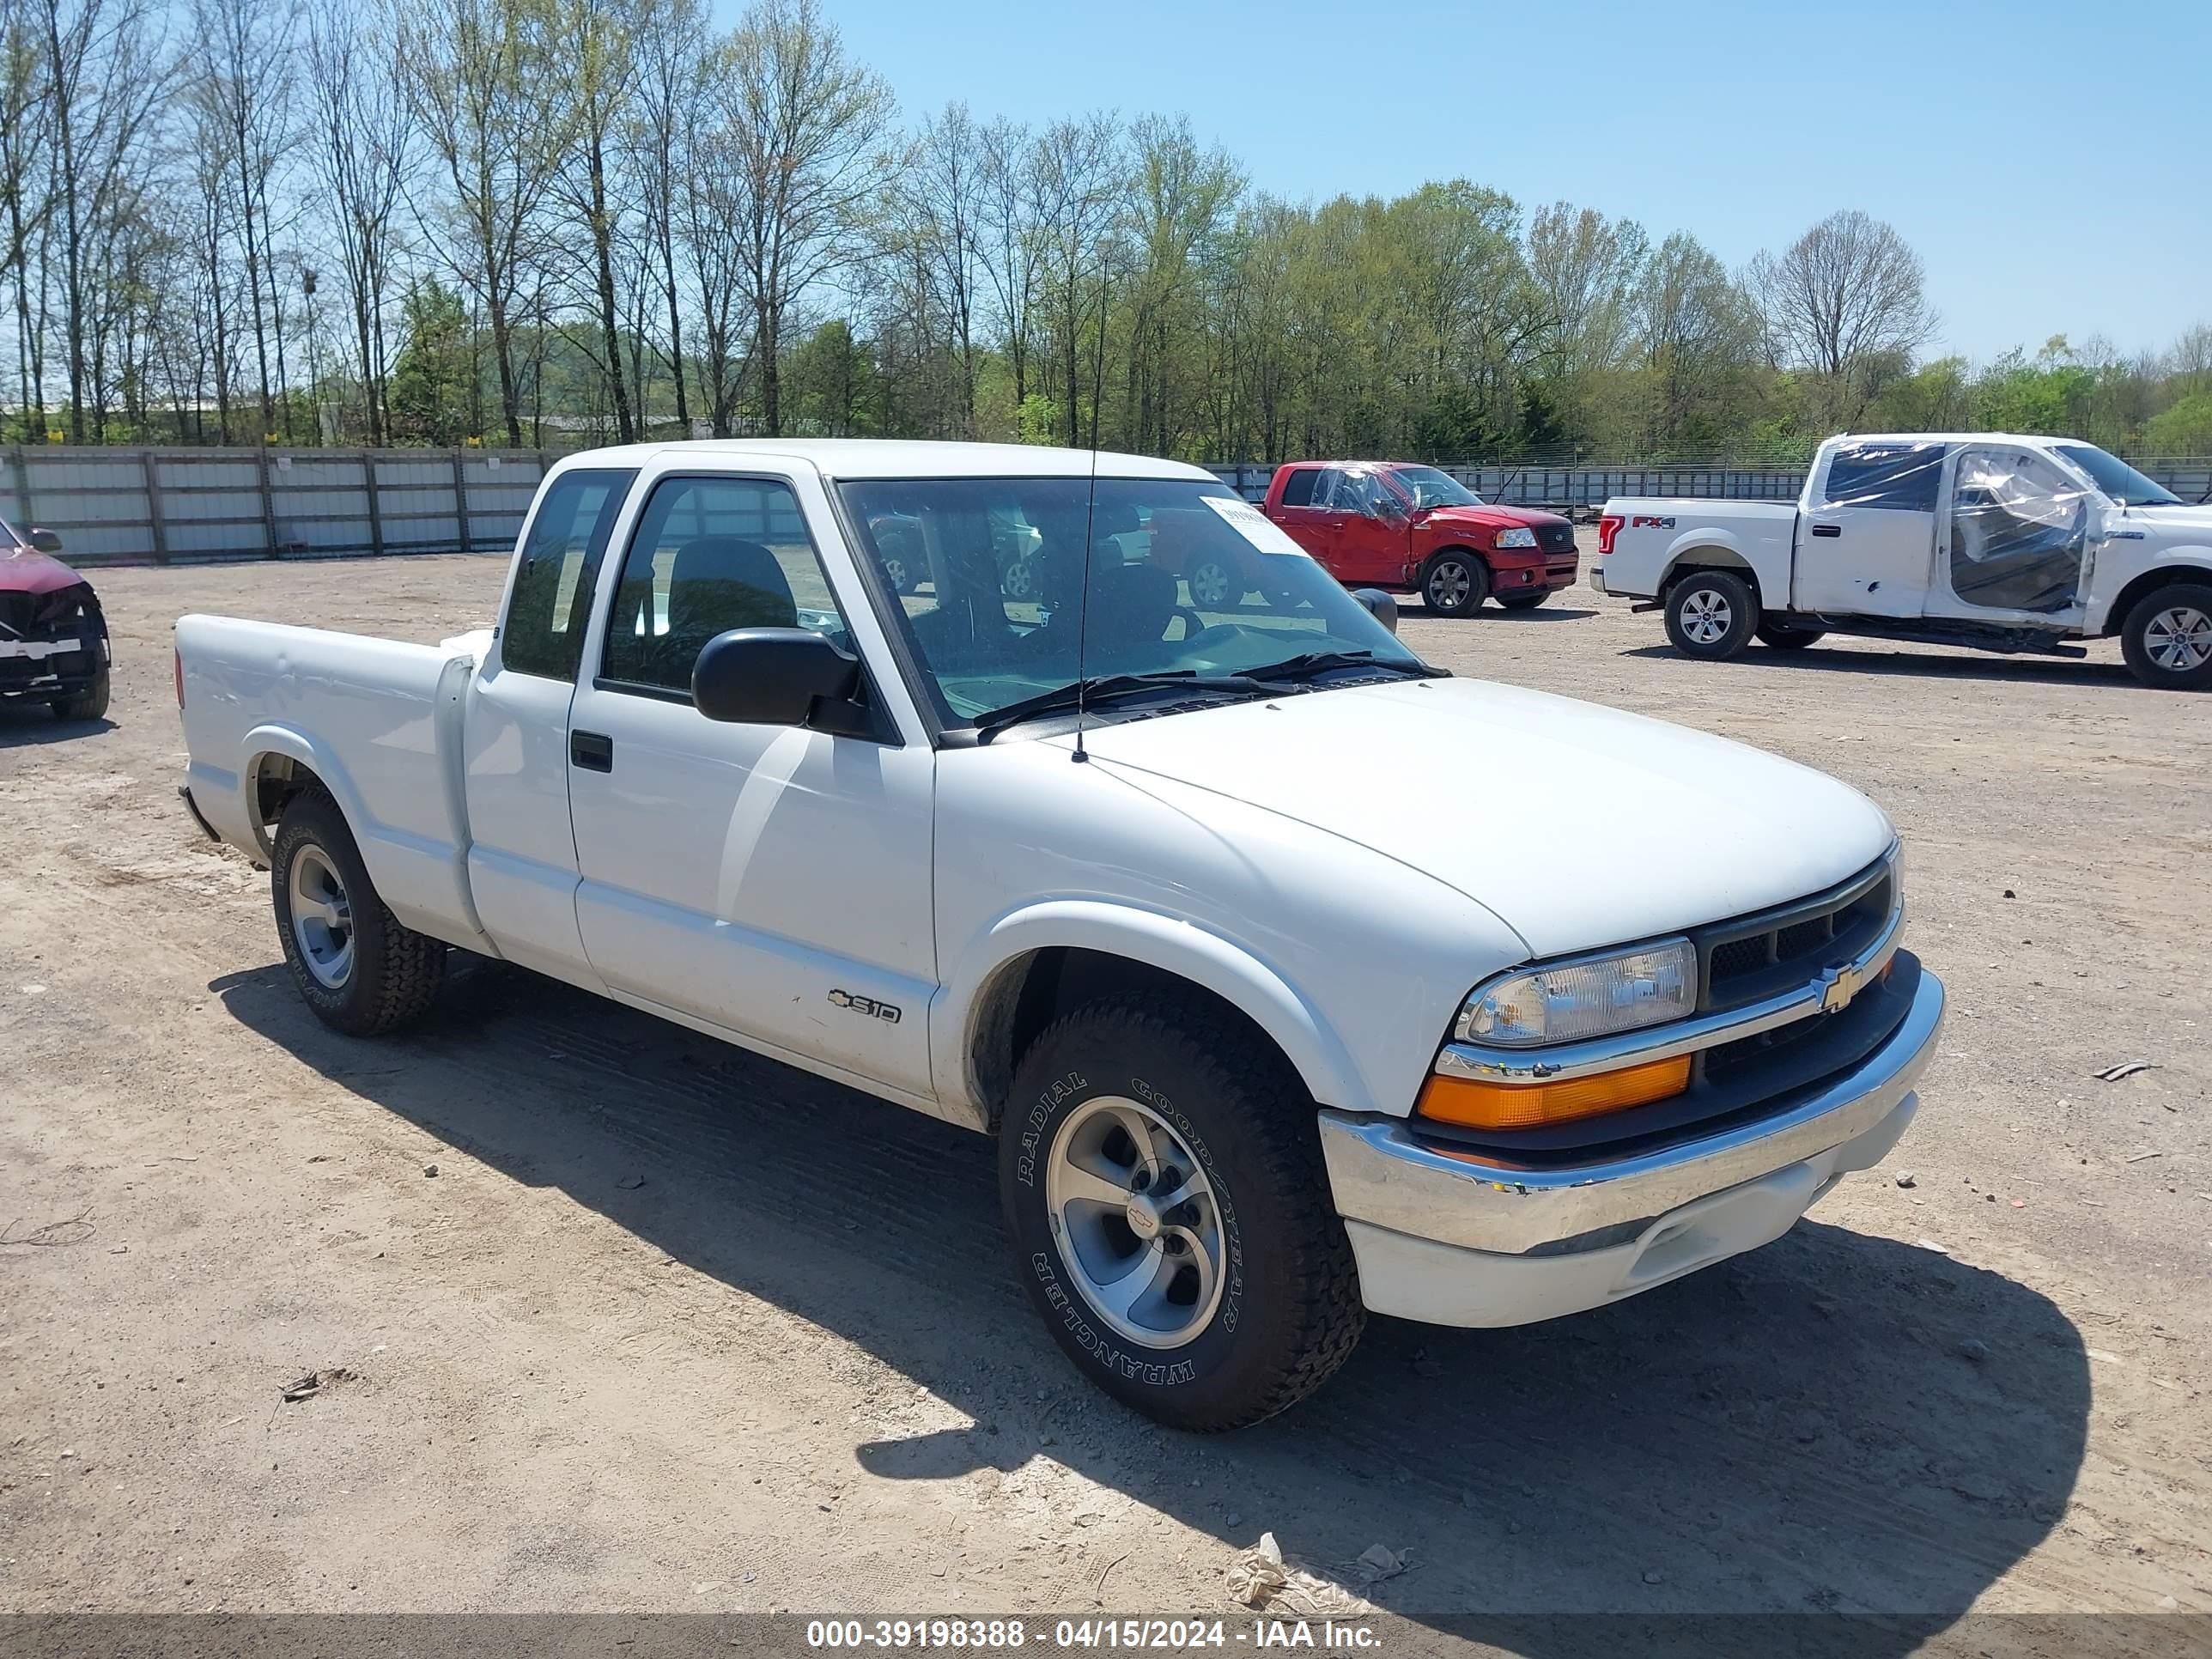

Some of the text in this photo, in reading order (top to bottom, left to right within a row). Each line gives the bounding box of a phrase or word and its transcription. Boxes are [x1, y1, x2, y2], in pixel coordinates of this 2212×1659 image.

[1632, 516, 1676, 527] FX4
[851, 995, 902, 1024] S10
[1018, 1071, 1088, 1187] RADIAL
[1131, 1077, 1243, 1333] GOODYEAR
[1031, 1251, 1196, 1386] WRANGLER
